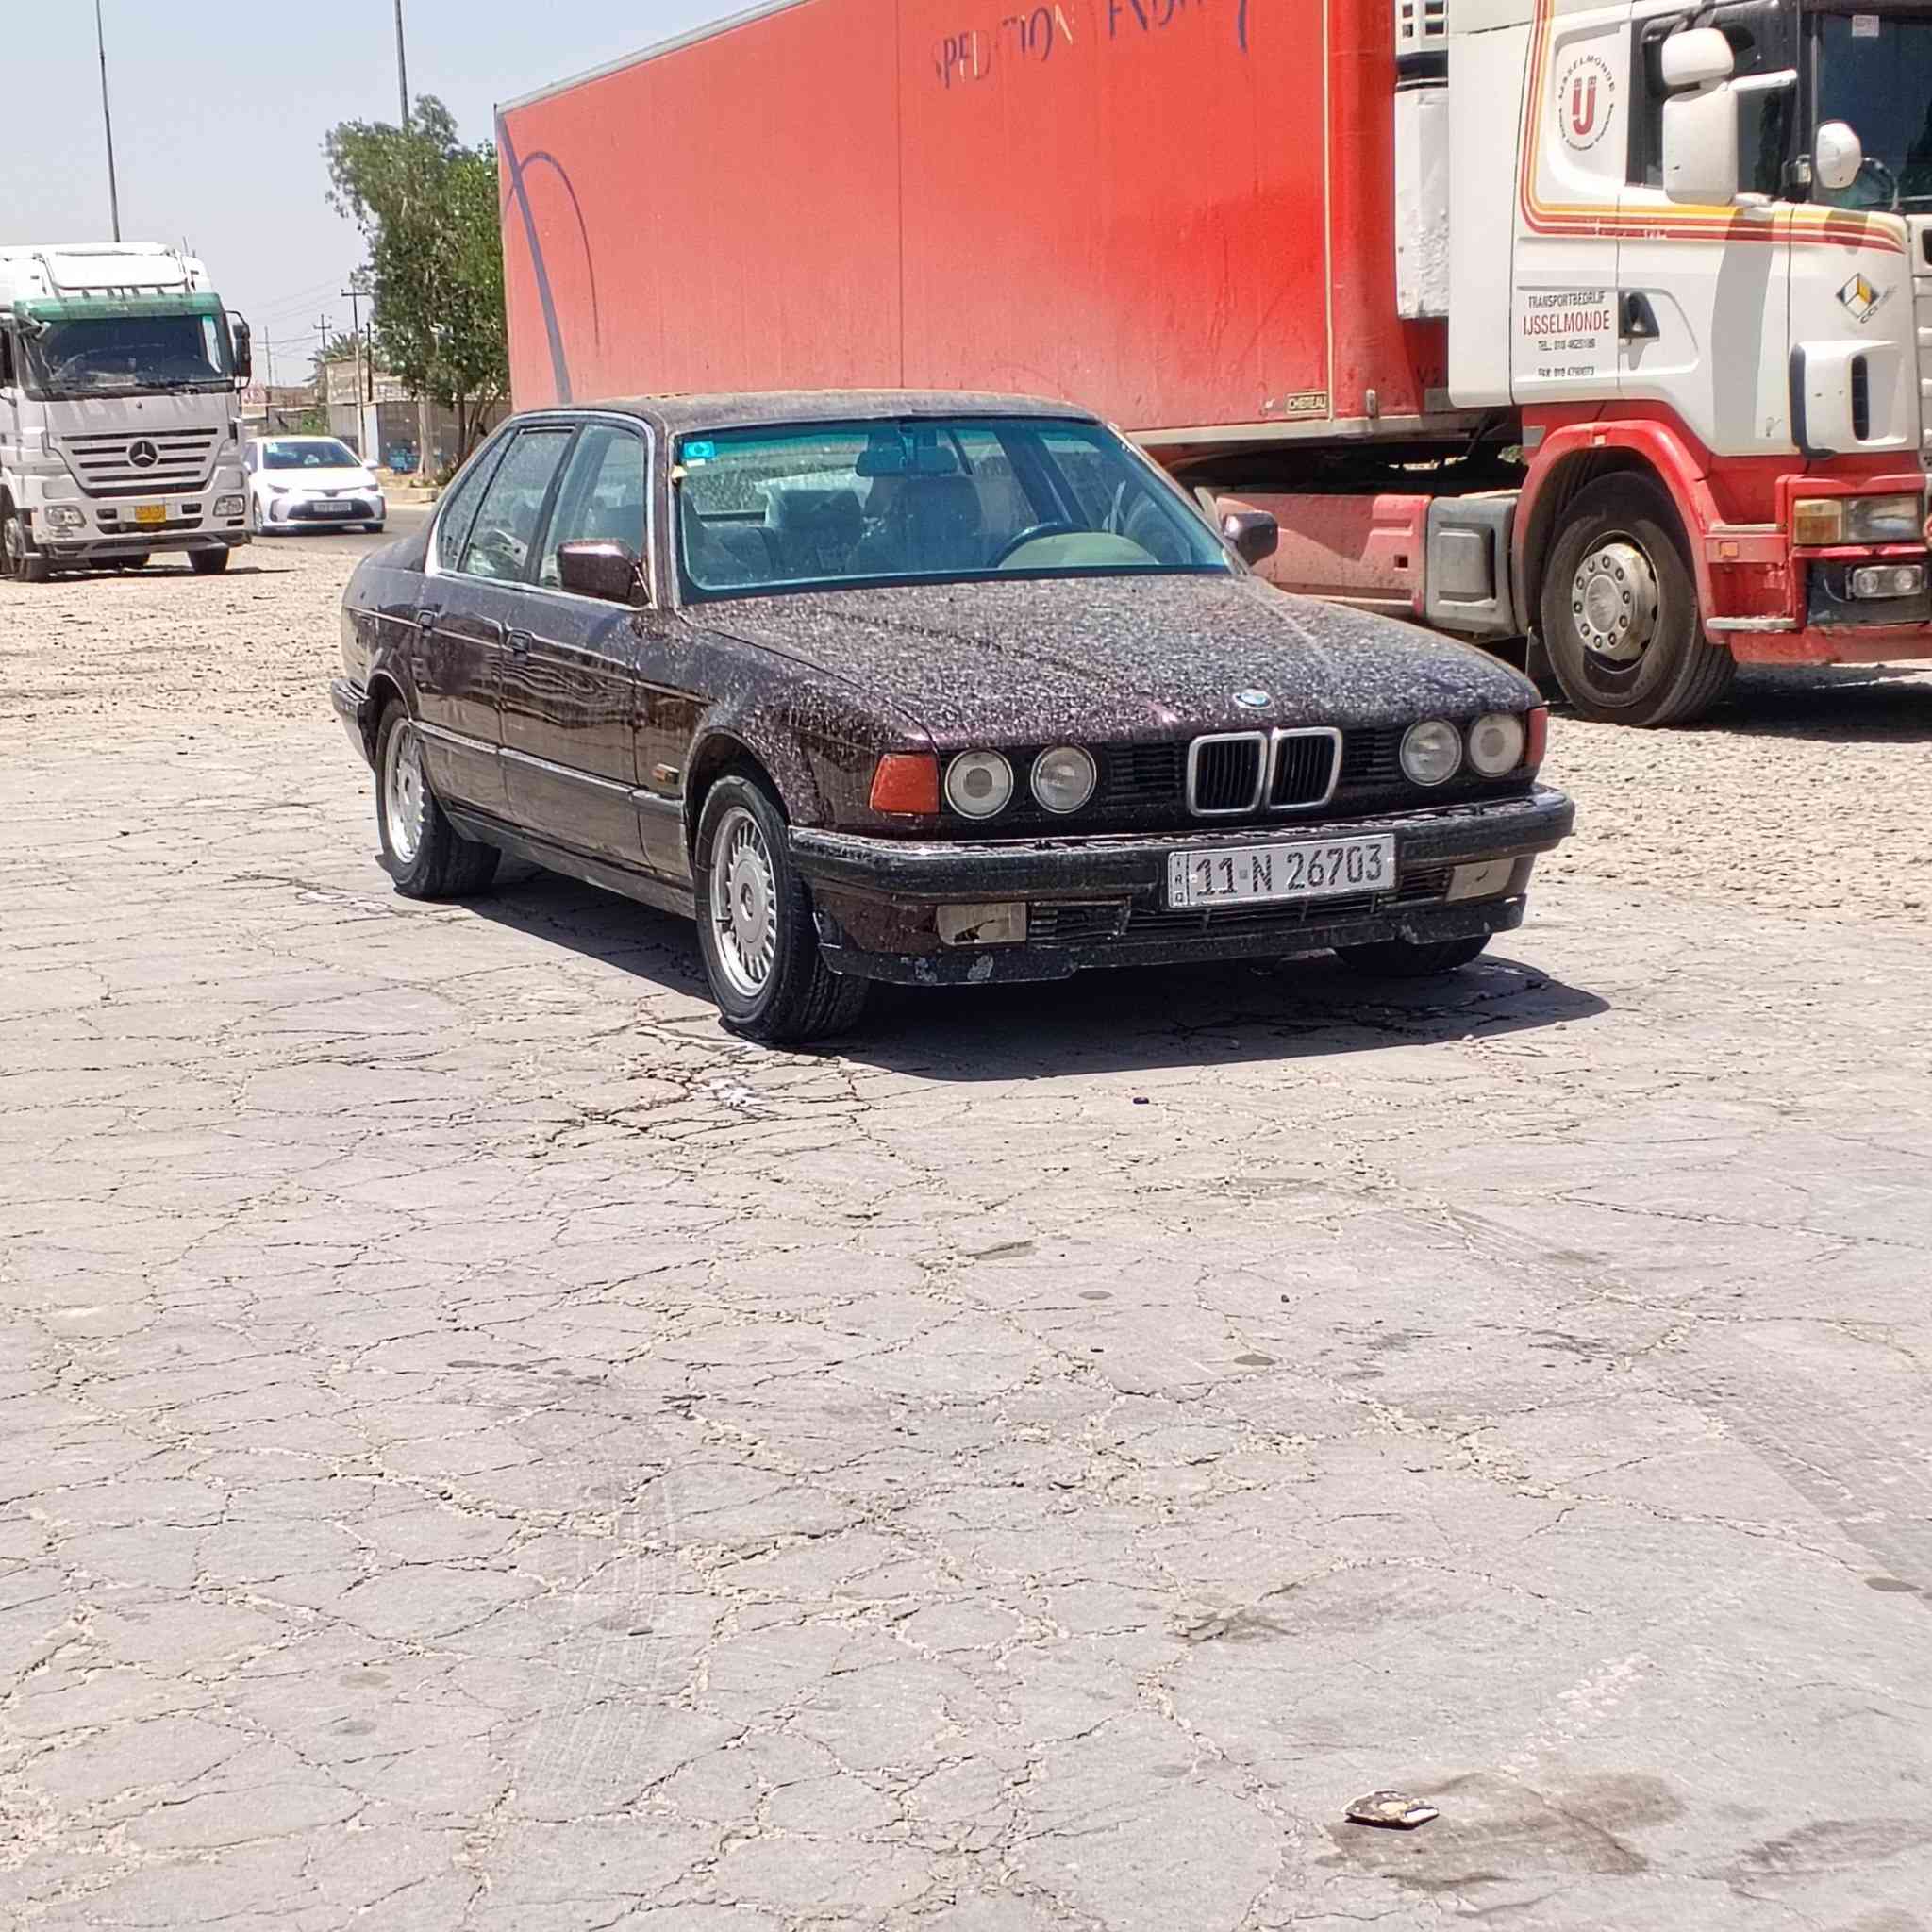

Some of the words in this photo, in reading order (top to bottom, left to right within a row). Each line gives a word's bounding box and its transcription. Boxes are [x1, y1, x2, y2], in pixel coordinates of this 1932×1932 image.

[1524, 310, 1609, 335] IJSSELMONDE
[1195, 857, 1238, 897] 11
[1251, 854, 1273, 892] N
[1286, 843, 1383, 891] 26703
